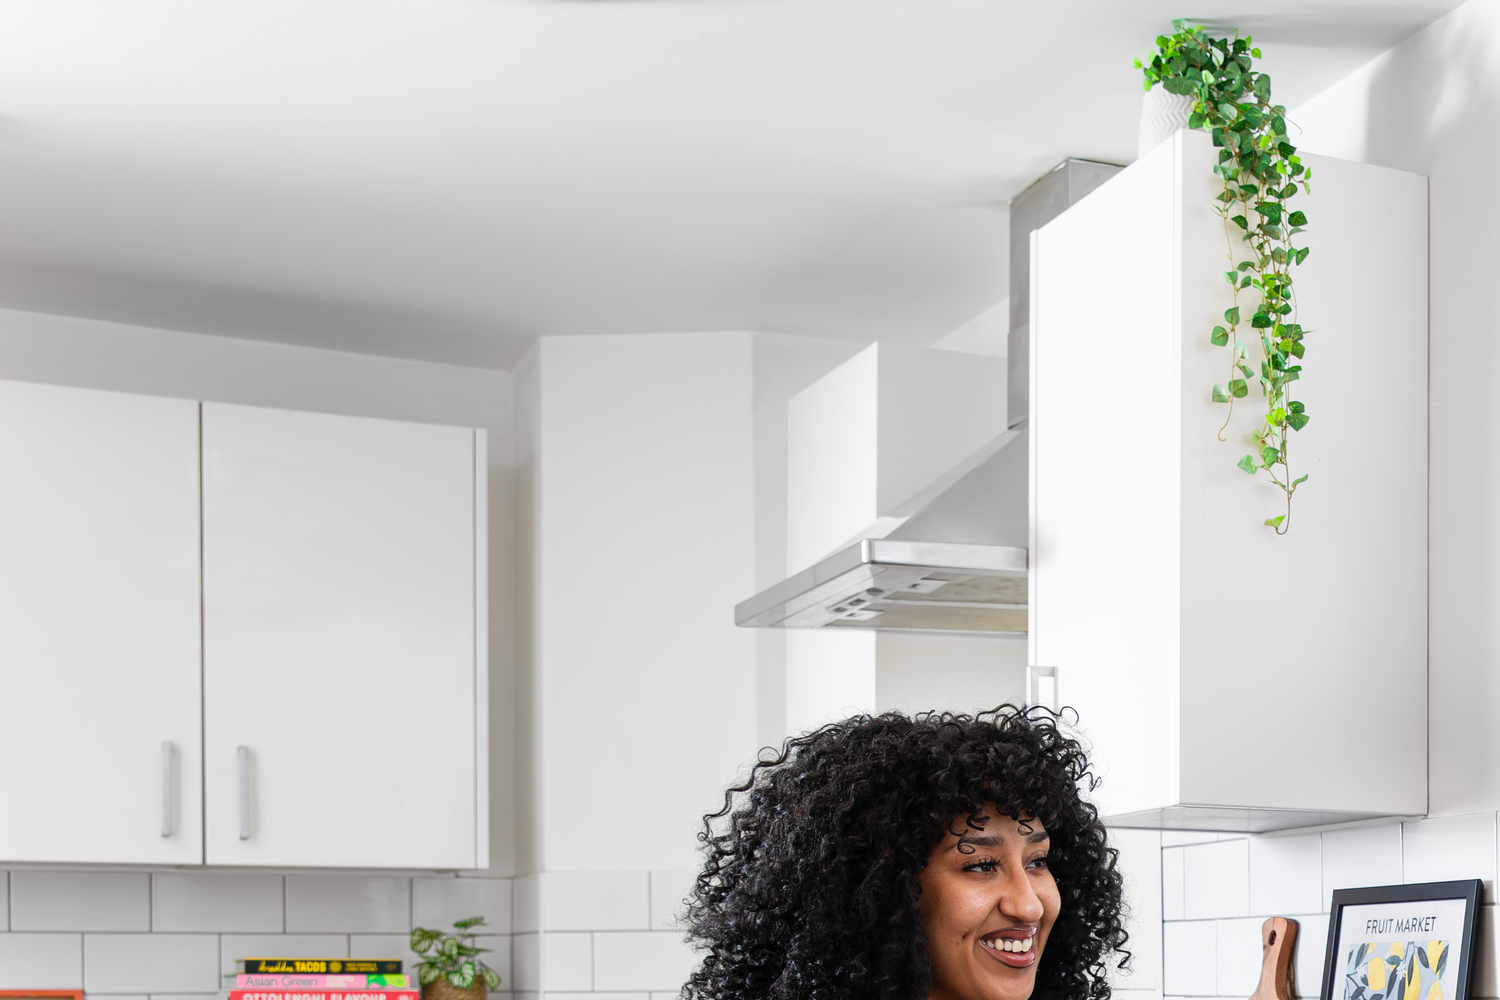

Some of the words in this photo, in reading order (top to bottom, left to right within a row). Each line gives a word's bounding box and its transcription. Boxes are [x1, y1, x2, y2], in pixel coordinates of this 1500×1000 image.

[1366, 918, 1394, 934] FRUIT
[1395, 916, 1437, 933] MARKET
[294, 961, 327, 973] TACOS
[245, 975, 278, 987] Asian
[281, 975, 318, 988] Green
